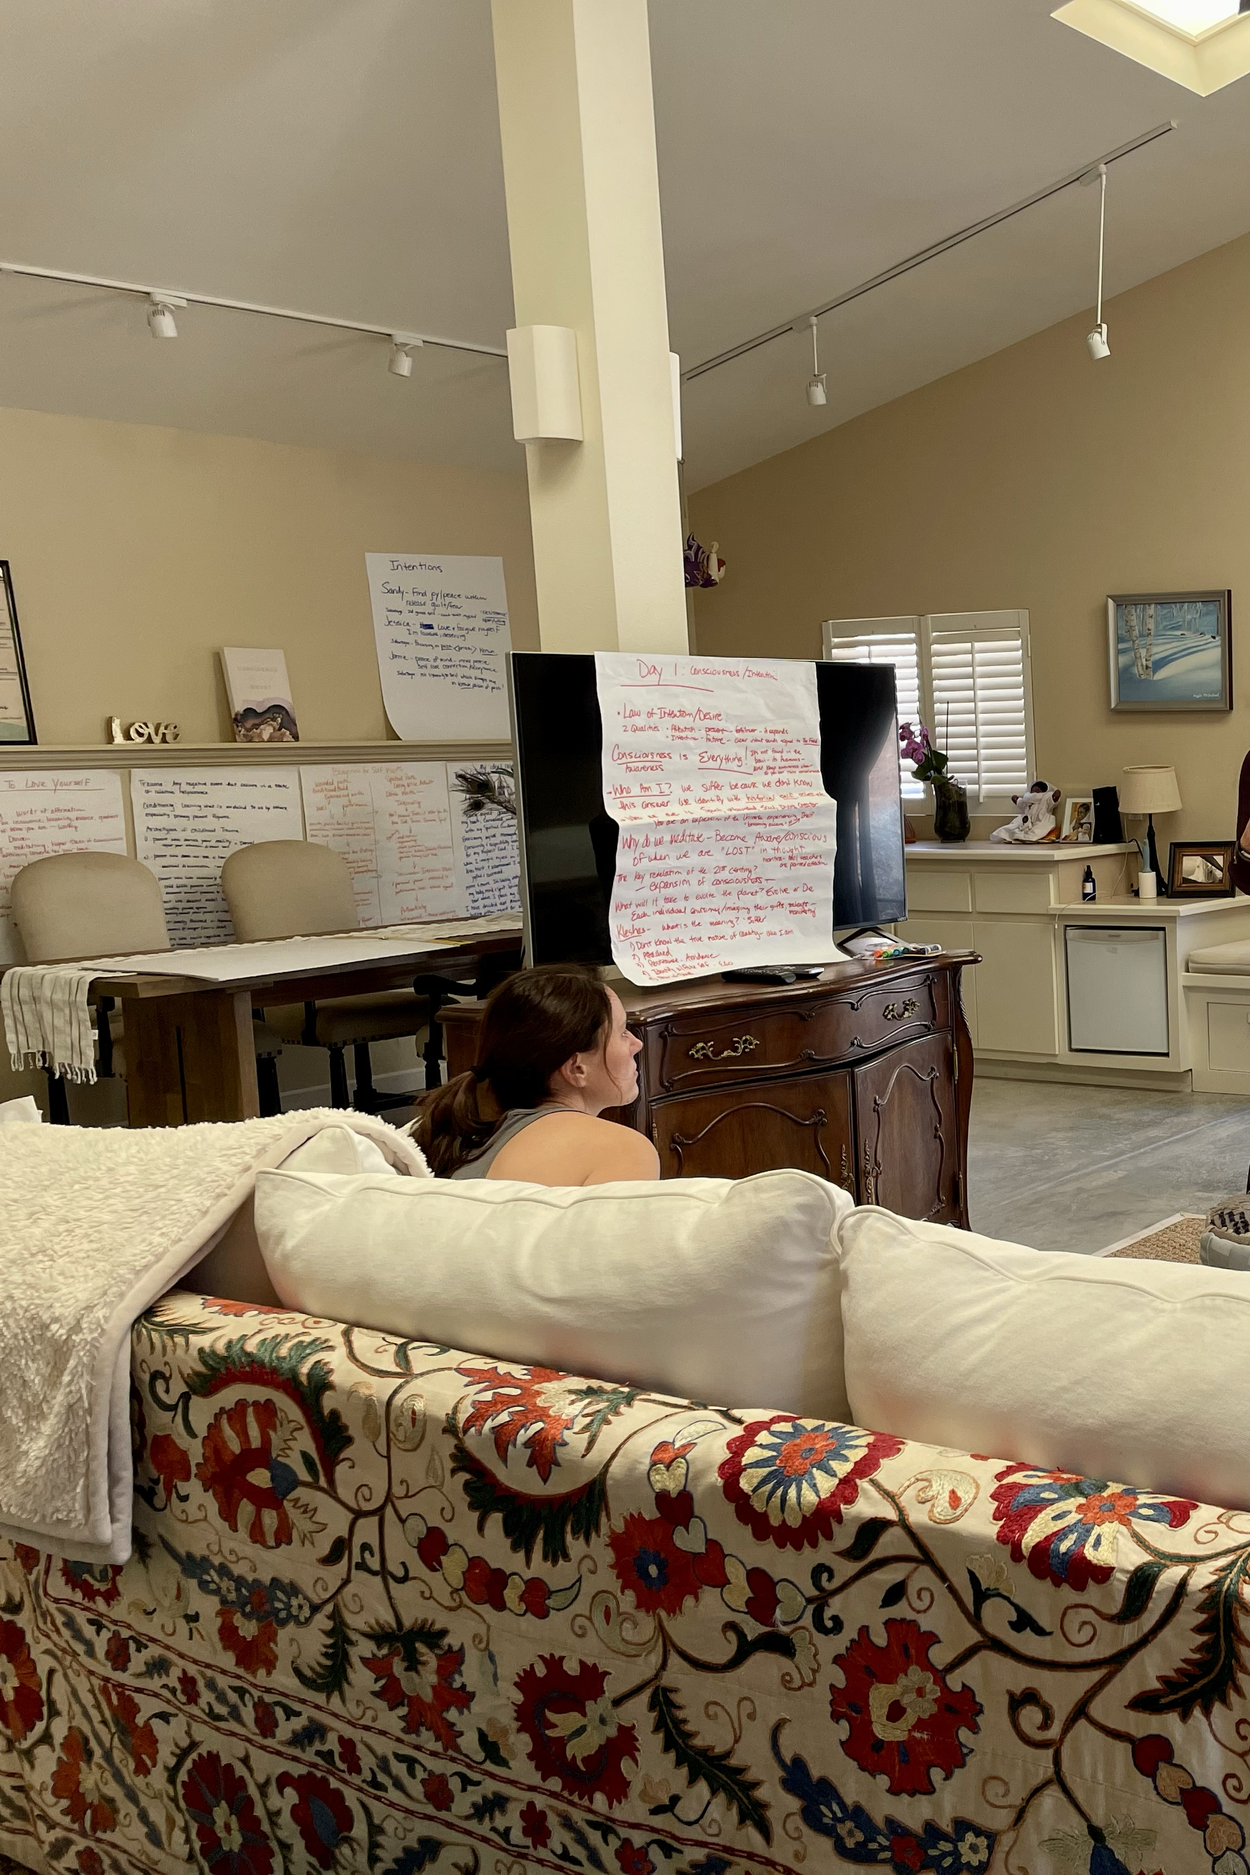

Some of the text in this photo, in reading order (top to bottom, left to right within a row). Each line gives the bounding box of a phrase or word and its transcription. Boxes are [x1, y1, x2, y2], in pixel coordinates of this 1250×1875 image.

[389, 560, 443, 573] Intentions
[637, 659, 663, 685] Day
[624, 703, 641, 719] Law
[647, 708, 657, 719] of
[107, 716, 181, 744] Love
[612, 744, 672, 762] Consciousness
[3, 780, 16, 789] To
[25, 779, 47, 788] Love
[640, 783, 652, 793] Am
[702, 781, 724, 792] suffer
[619, 801, 636, 810] this
[642, 801, 670, 809] answer
[695, 795, 723, 805] identify
[622, 834, 640, 855] Why
[642, 833, 650, 848] do
[654, 836, 665, 847] we
[715, 829, 748, 842] Become
[648, 852, 670, 862] when
[676, 851, 690, 860] we
[698, 849, 714, 857] are
[687, 867, 694, 875] of
[698, 877, 706, 886] of
[712, 876, 762, 886] consciousness
[615, 902, 633, 912] What
[635, 899, 647, 908] will
[664, 896, 677, 904] take
[631, 911, 651, 921] Each
[653, 906, 686, 916] individual
[730, 932, 737, 940] of
